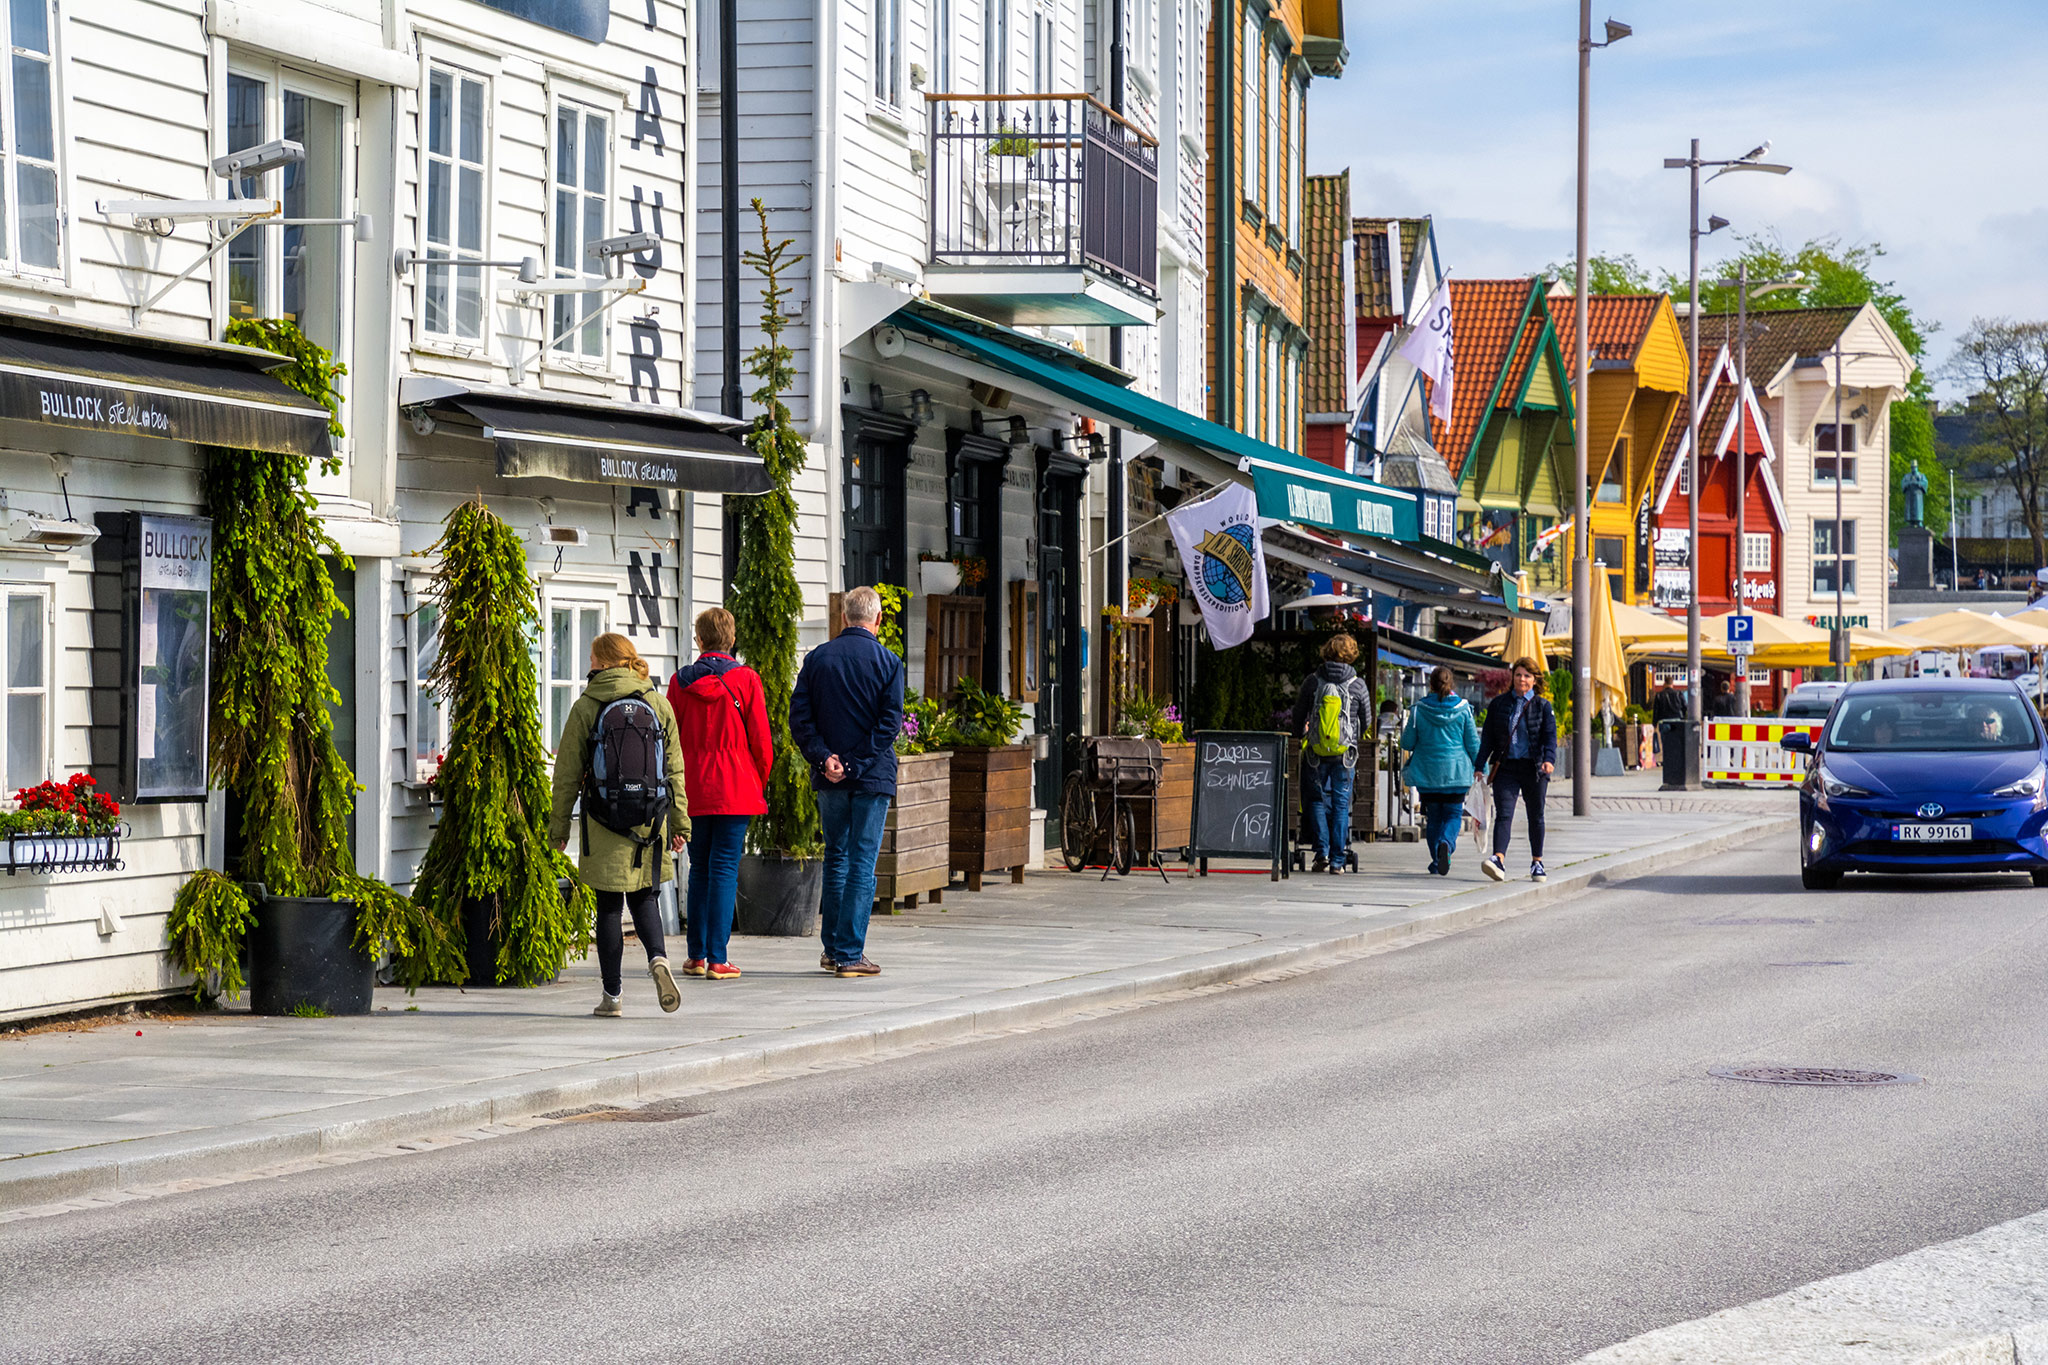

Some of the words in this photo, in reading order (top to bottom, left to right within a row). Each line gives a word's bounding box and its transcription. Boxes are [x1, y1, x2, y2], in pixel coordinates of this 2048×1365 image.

[40, 391, 105, 422] BULLOCK
[601, 458, 639, 480] BULLOCK
[1219, 513, 1250, 528] WORLD
[145, 532, 207, 561] BULLOCK
[1211, 534, 1229, 557] N.B.
[1734, 619, 1748, 639] P
[1204, 742, 1263, 765] Dagens
[1904, 826, 1921, 839] RK
[1928, 826, 1967, 839] 99161
